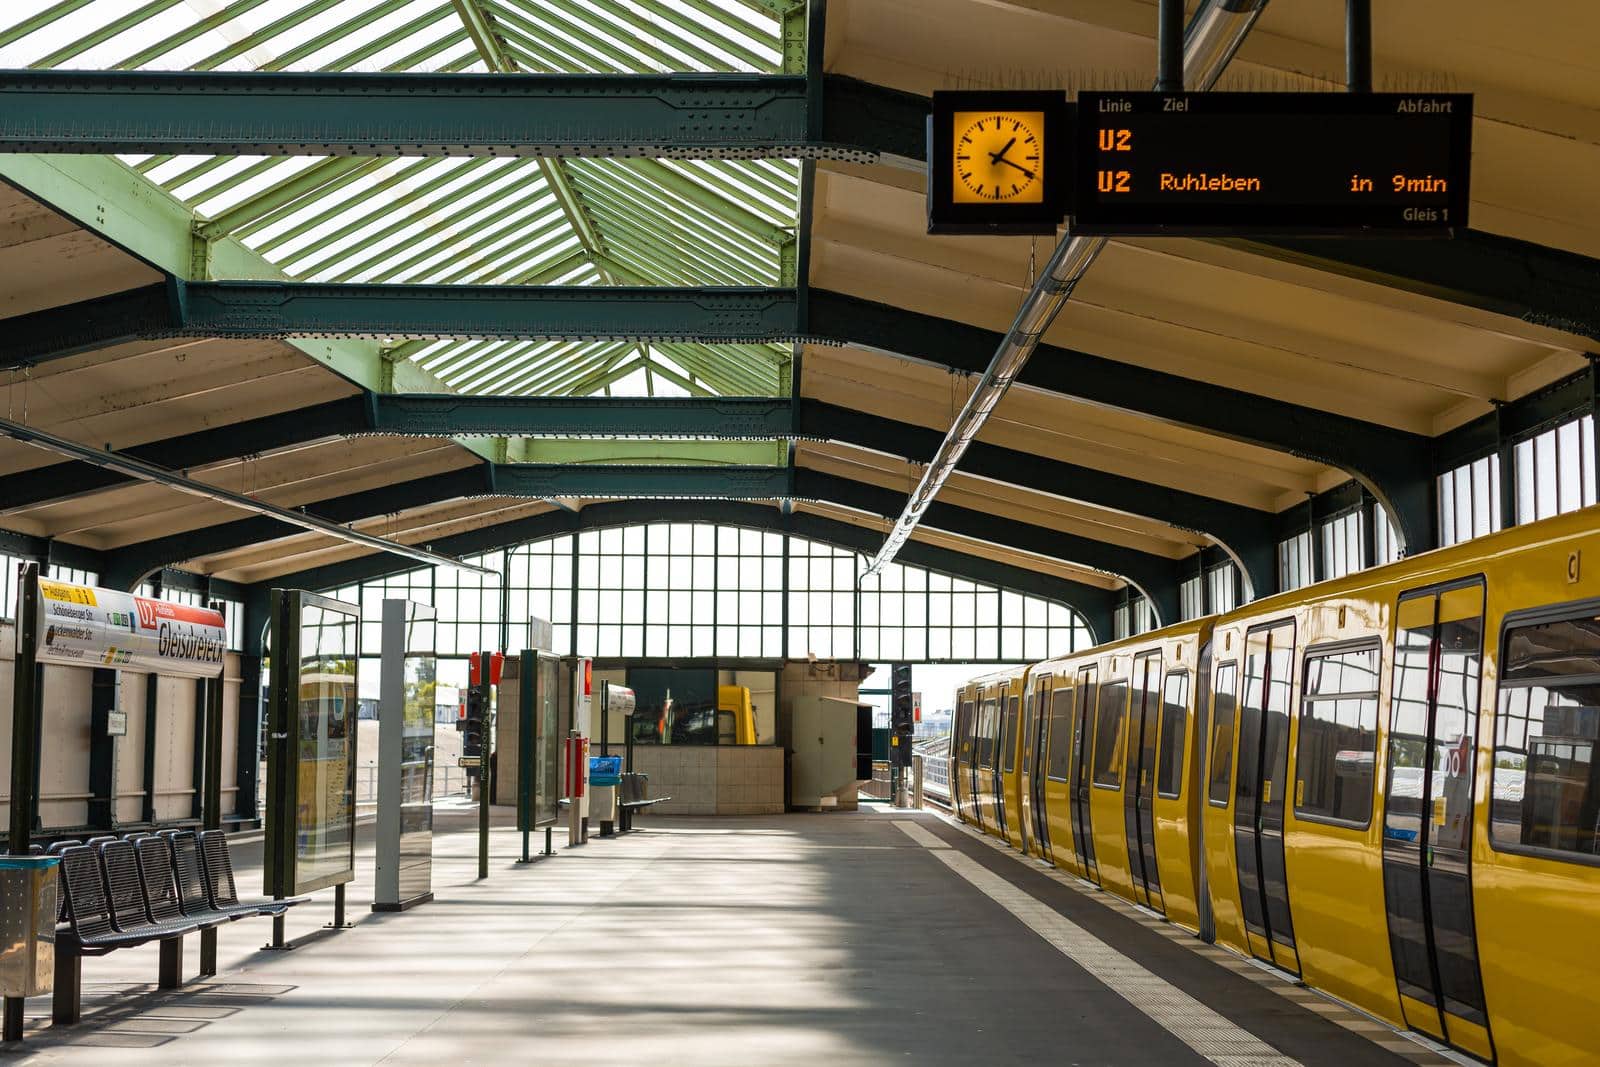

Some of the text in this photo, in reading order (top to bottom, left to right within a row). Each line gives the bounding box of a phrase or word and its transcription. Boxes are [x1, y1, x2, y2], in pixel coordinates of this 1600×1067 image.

[1099, 99, 1132, 112] Linie
[1163, 98, 1189, 112] Ziel
[1397, 99, 1452, 113] Abfahrt
[1099, 129, 1132, 151] U2
[1098, 171, 1447, 192] U2 Ruhleben in 9min
[1403, 207, 1448, 221] Gleis 1
[136, 600, 156, 626] U2
[158, 621, 224, 663] Gleisdreieck
